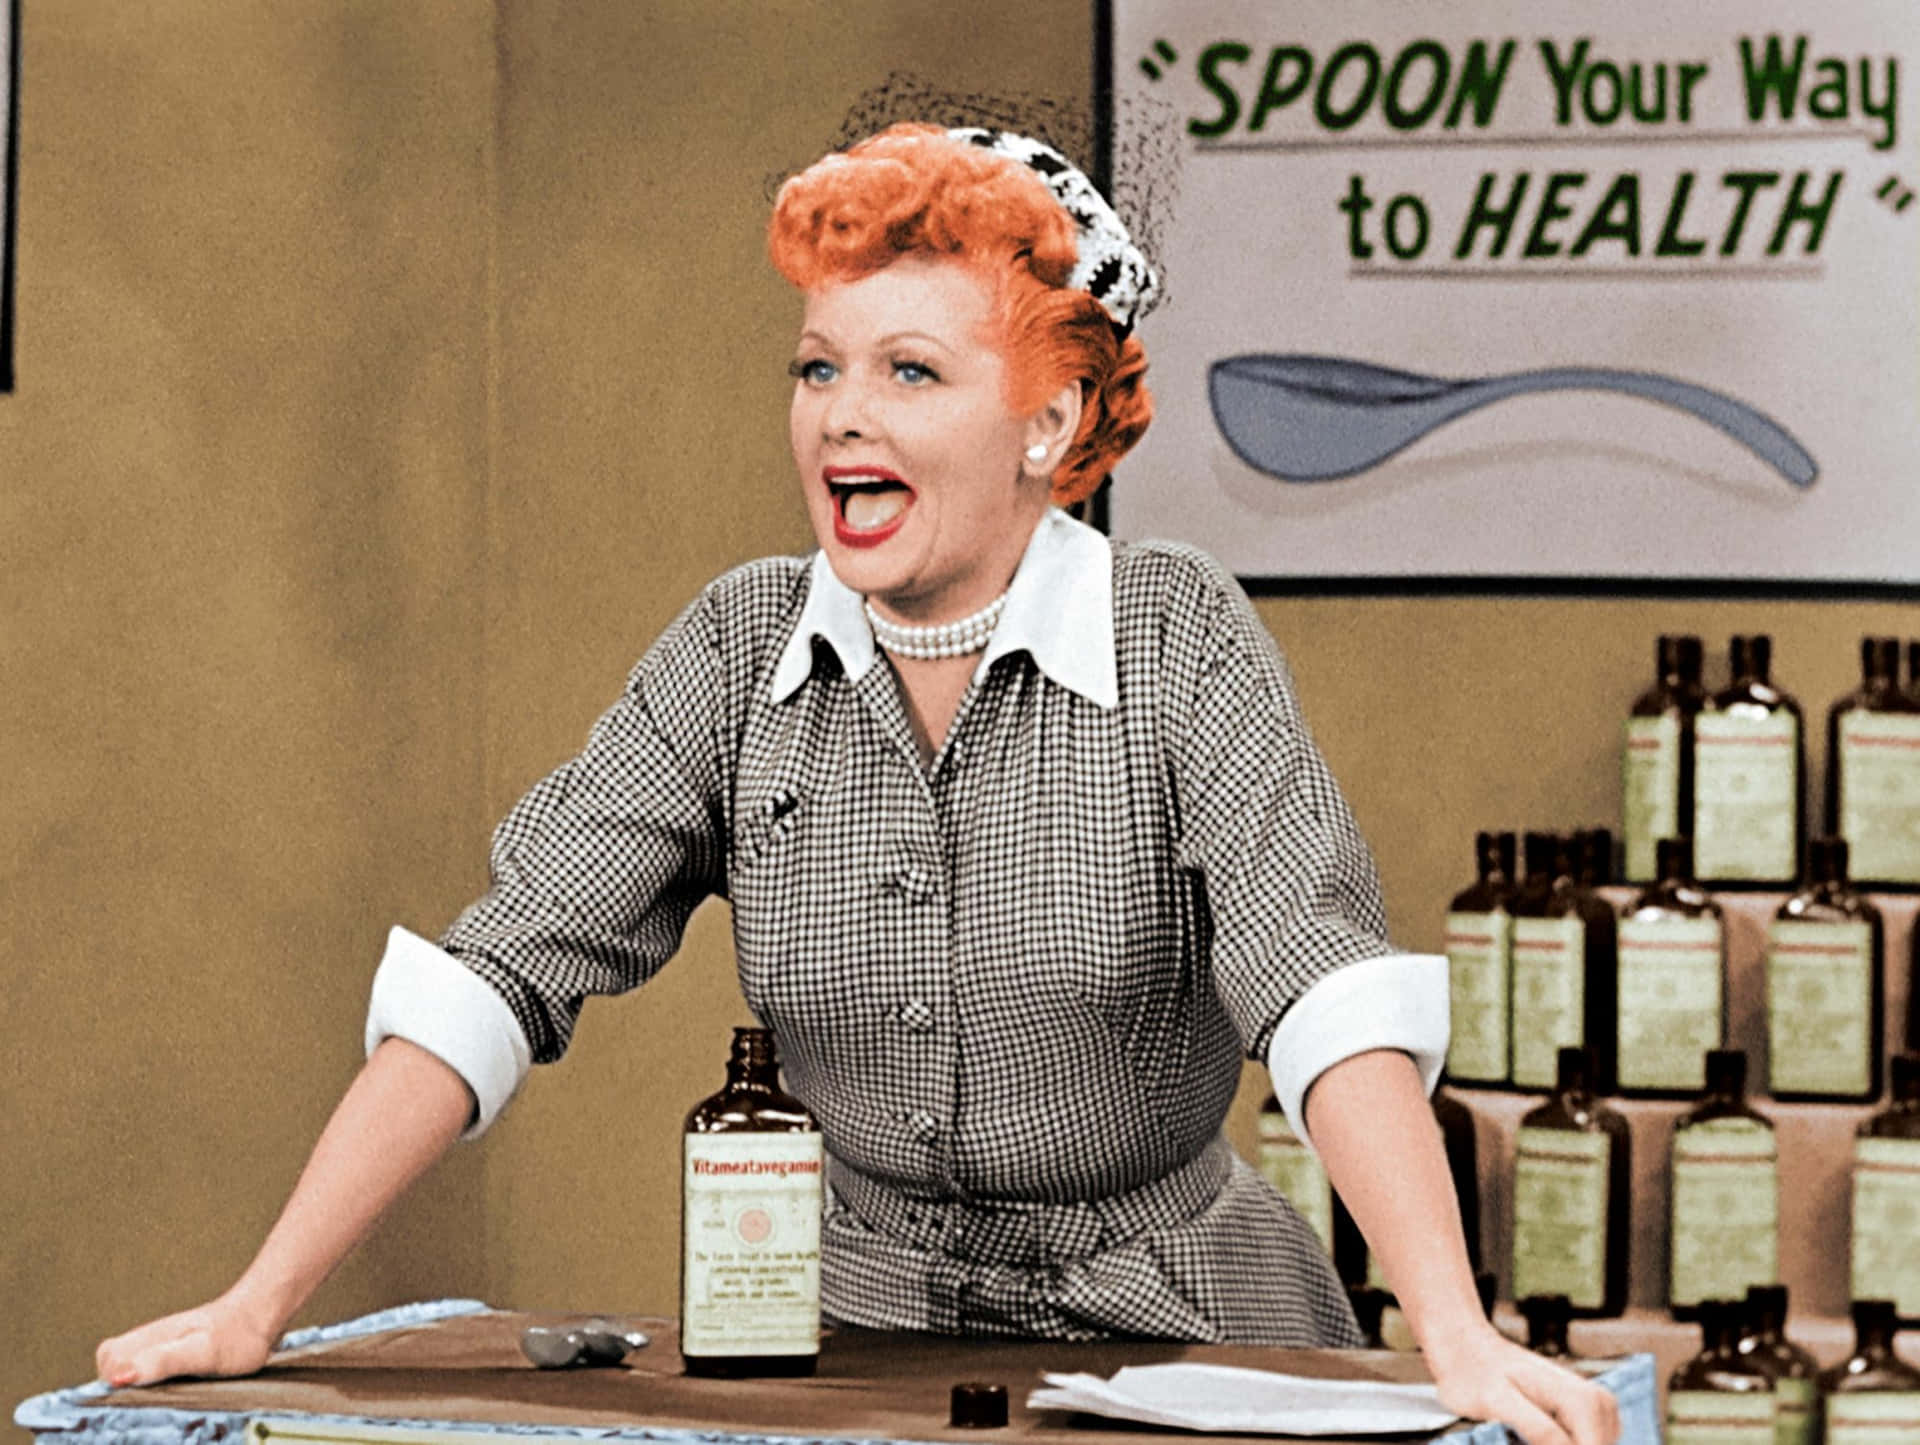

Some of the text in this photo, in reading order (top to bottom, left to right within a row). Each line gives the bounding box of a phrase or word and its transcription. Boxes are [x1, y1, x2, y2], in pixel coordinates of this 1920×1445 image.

[1137, 34, 1899, 151] "SPOON Your Way
[1337, 173, 1431, 262] to
